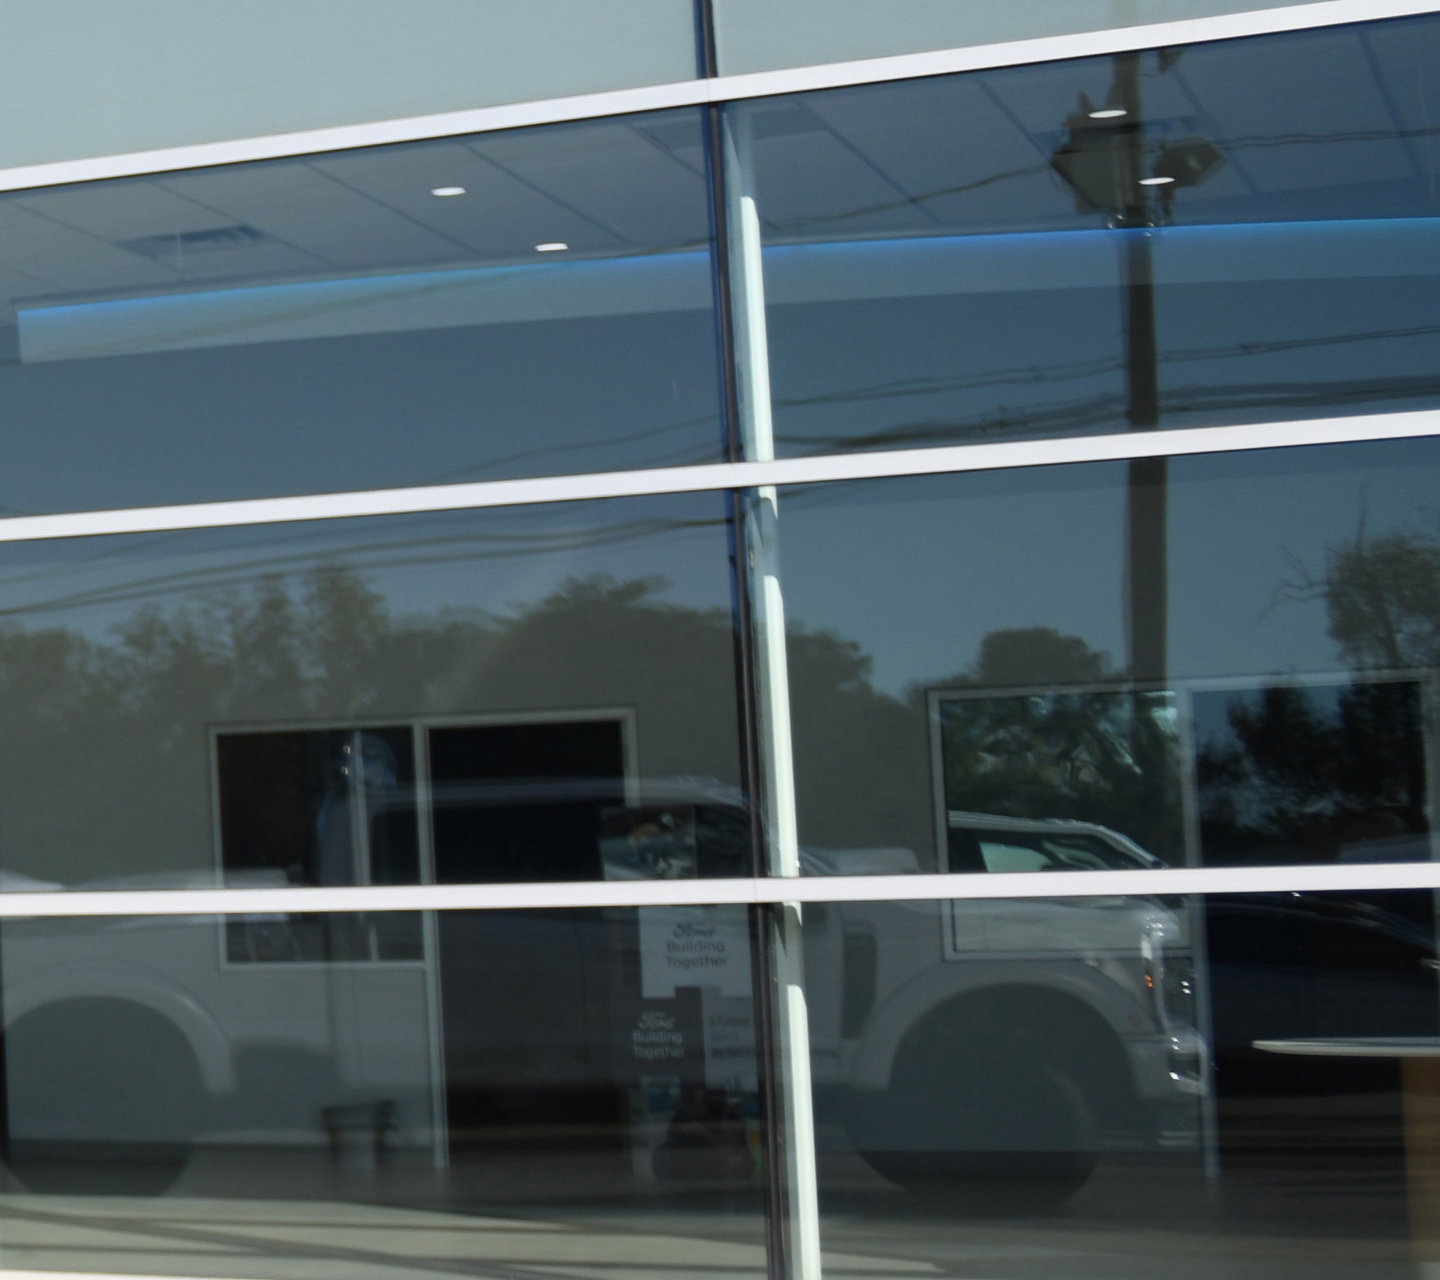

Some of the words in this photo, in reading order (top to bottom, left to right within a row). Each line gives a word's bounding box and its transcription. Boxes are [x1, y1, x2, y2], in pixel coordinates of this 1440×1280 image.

[666, 941, 726, 954] Building
[666, 955, 728, 969] Together
[633, 1030, 683, 1044] Building
[633, 1044, 685, 1060] Together
